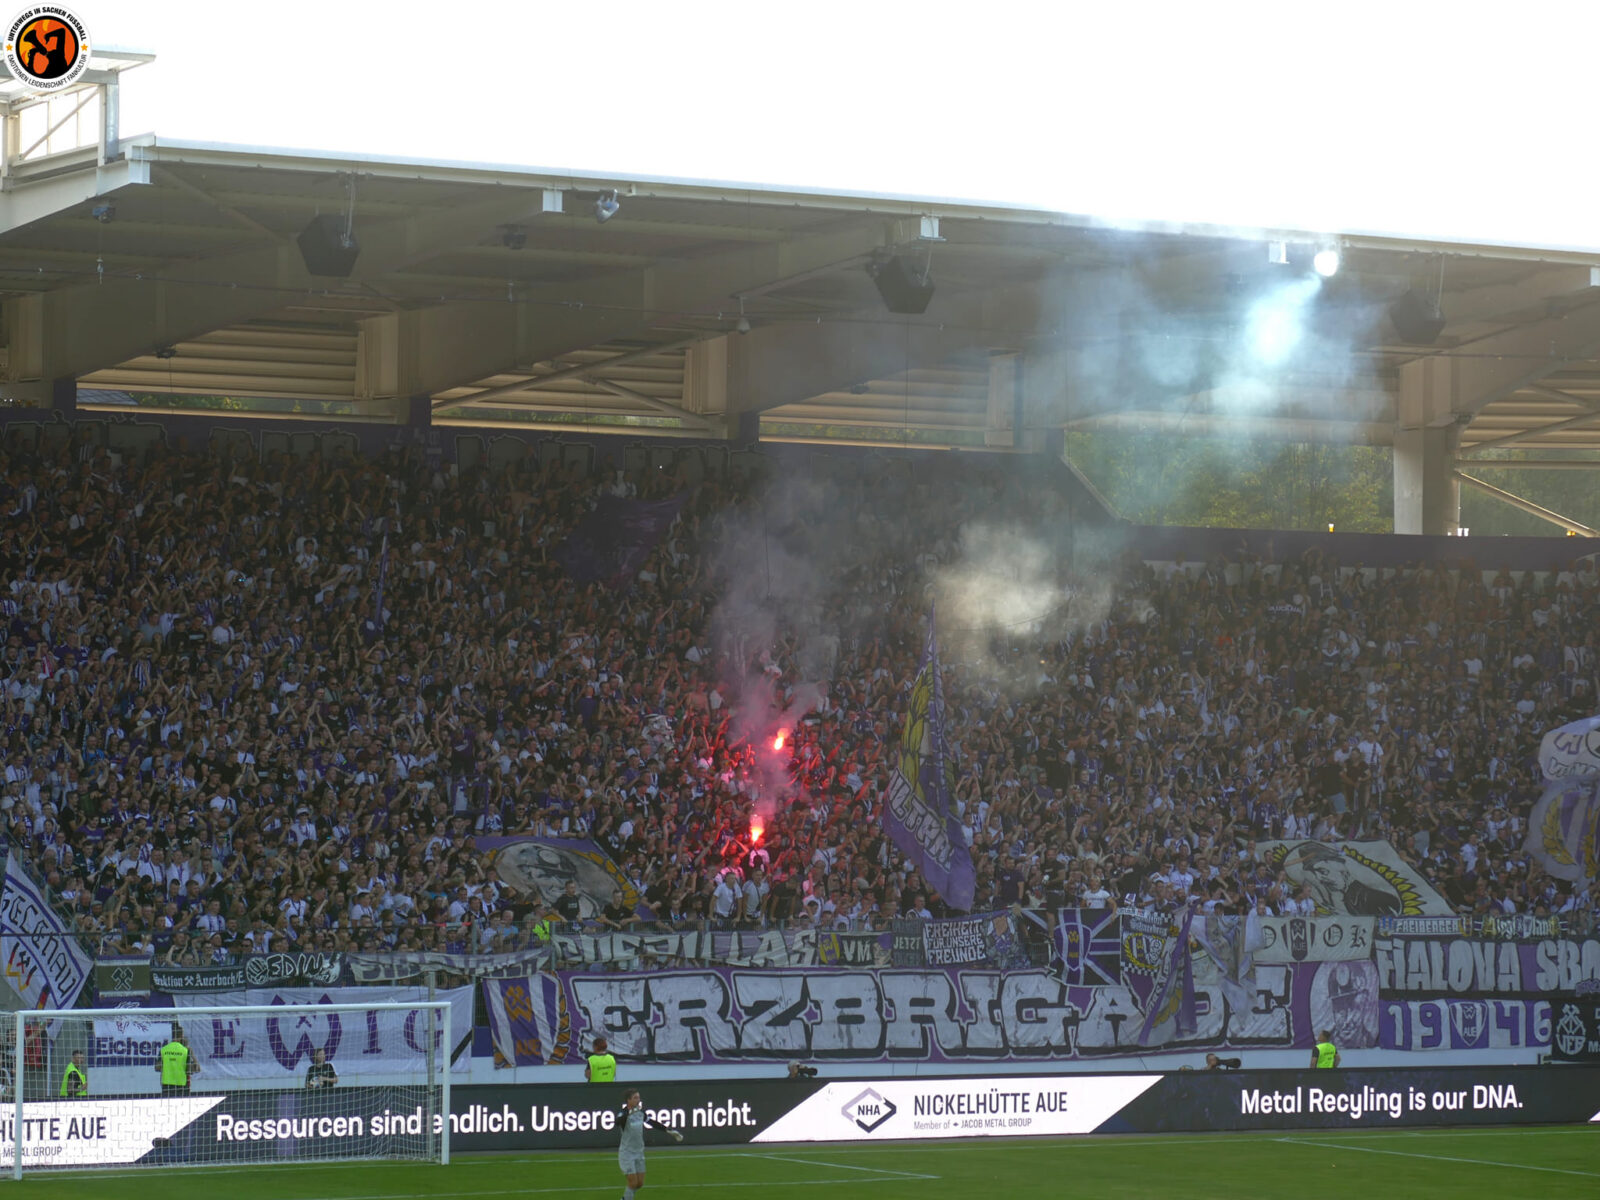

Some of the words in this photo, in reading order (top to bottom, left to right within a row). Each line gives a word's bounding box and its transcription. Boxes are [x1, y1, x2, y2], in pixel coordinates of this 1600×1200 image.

[925, 919, 983, 939] FREIHEIT
[893, 936, 922, 950] JETZT
[949, 933, 983, 948] UNSERE
[842, 939, 872, 964] VM
[927, 945, 987, 965] FREUNDE
[1375, 939, 1520, 992] FIALOVA
[571, 972, 1295, 1063] ERZBRIGADE
[857, 1104, 881, 1116] NHA
[914, 1088, 1030, 1115] NICKELHÜTTE
[1035, 1091, 1068, 1112] AUE
[1241, 1086, 1302, 1114] Metal
[1309, 1085, 1402, 1119] Recyling
[1409, 1086, 1426, 1111] is
[1432, 1088, 1468, 1111] our
[1473, 1085, 1523, 1110] DNA.
[67, 1117, 106, 1139] AUE
[216, 1114, 363, 1141] Ressourcen
[370, 1106, 422, 1136] sind
[432, 1104, 524, 1133] endlich.
[531, 1104, 615, 1132] Unsere
[622, 1101, 686, 1129] een
[692, 1099, 757, 1128] nicht.
[914, 1120, 941, 1130] Member
[943, 1119, 951, 1129] of
[961, 1118, 984, 1129] JACOB
[985, 1118, 1007, 1128] METAL
[1008, 1117, 1032, 1128] GROUP
[3, 1147, 30, 1157] MEAL
[33, 1146, 62, 1156] GROUP
